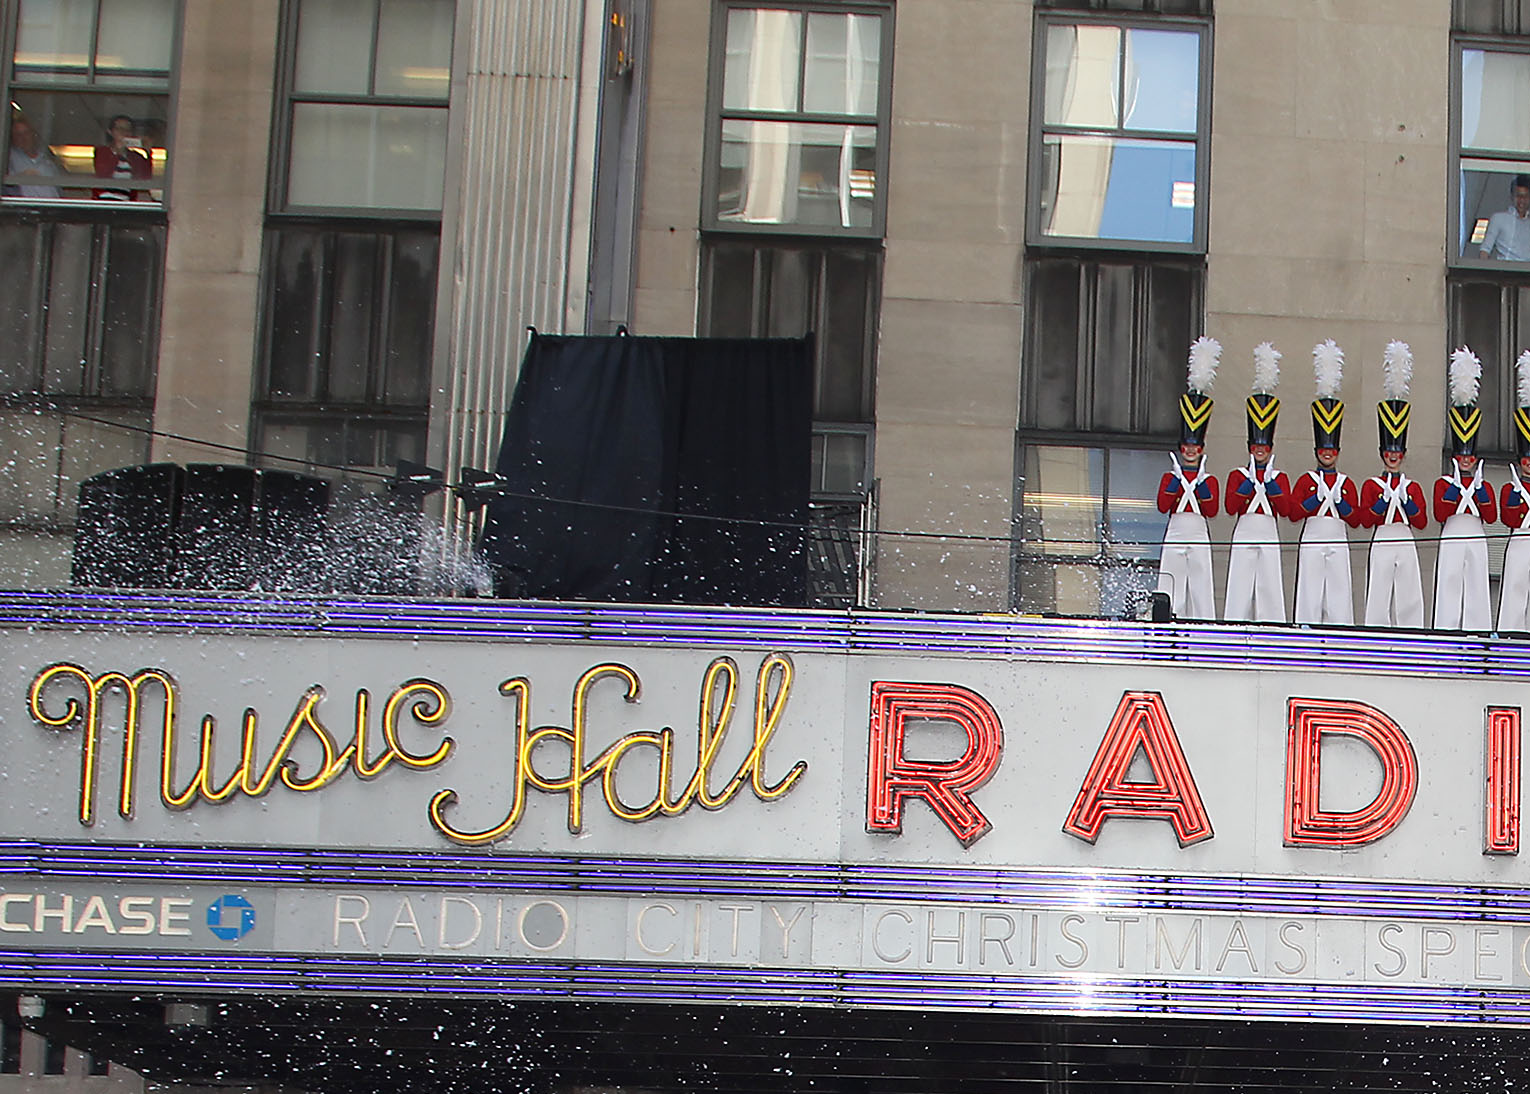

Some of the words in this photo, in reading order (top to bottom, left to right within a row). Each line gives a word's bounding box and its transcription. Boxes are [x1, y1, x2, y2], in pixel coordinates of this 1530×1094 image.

[27, 661, 456, 827] Music
[429, 652, 807, 846] Hall
[0, 893, 194, 936] CHASE
[333, 894, 570, 952] RADIO
[635, 902, 808, 960] CITY
[872, 908, 1308, 976] CHRISTMAS
